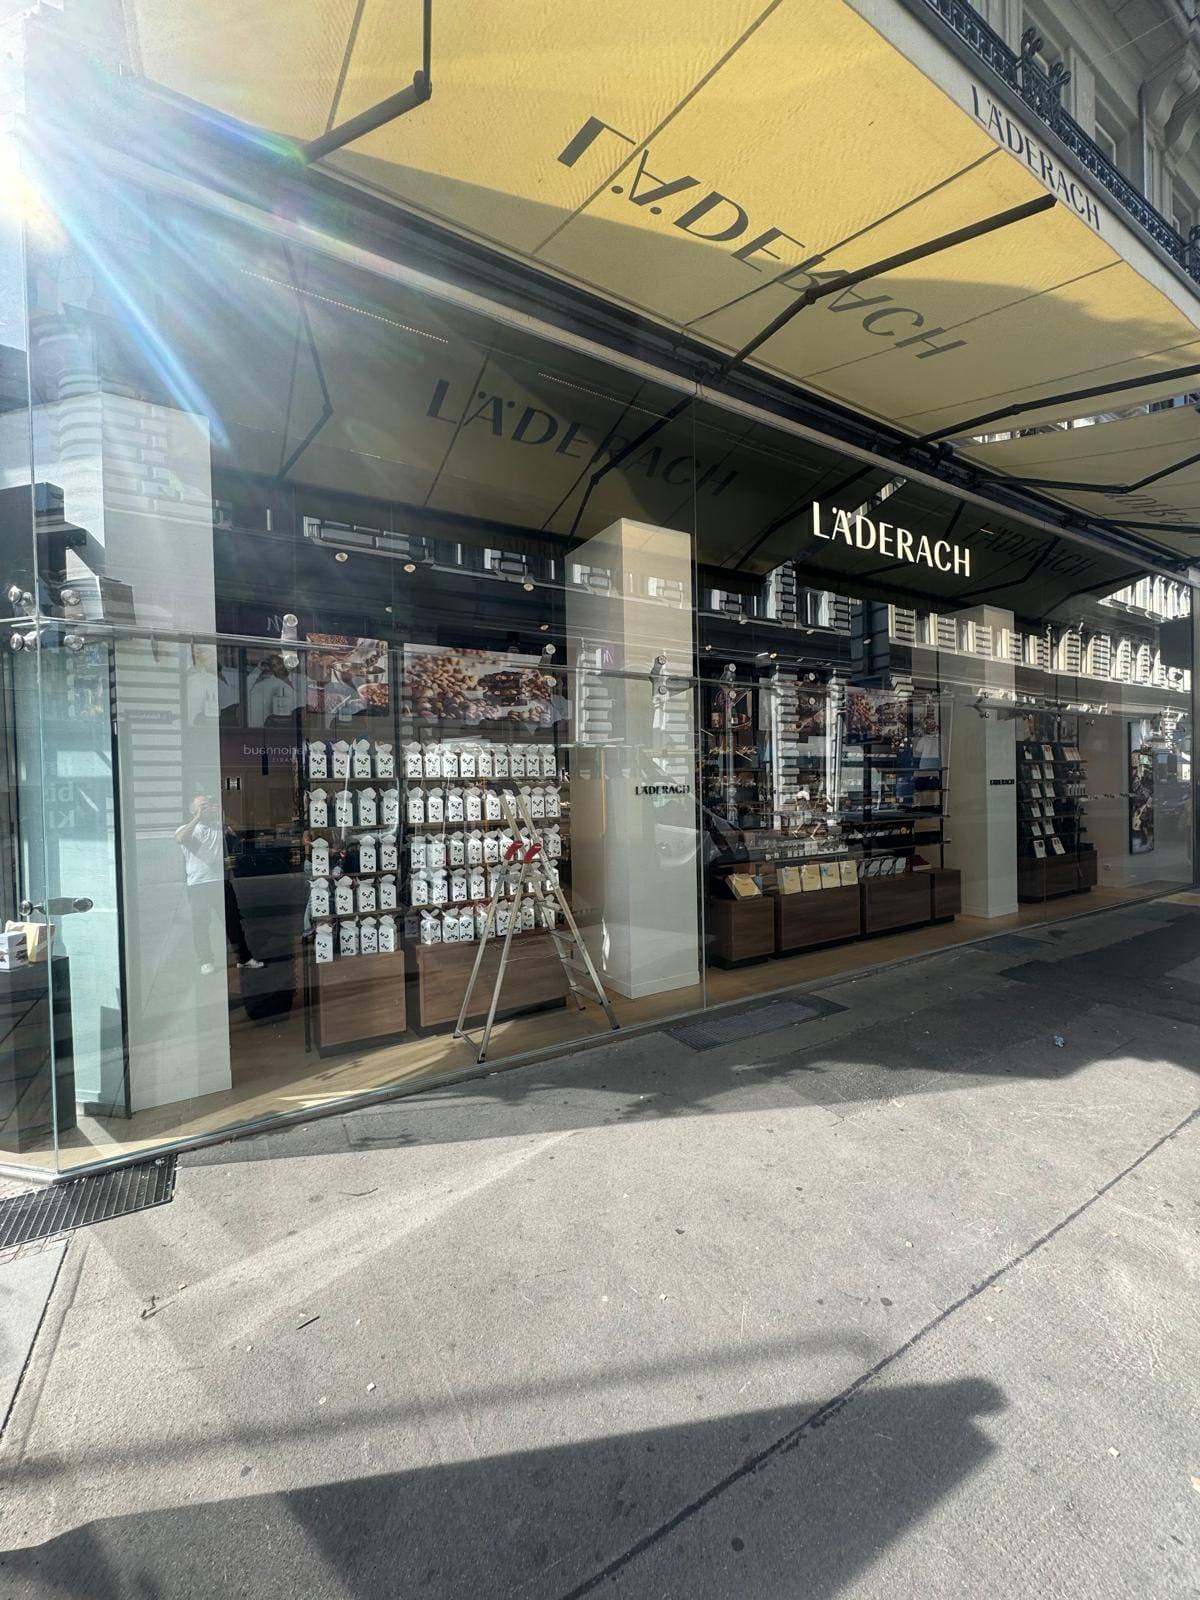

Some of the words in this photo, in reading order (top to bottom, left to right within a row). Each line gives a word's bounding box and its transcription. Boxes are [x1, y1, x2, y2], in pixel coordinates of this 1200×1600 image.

[970, 84, 1101, 231] LÄDERACH
[426, 378, 739, 497] LÄDERACH
[811, 501, 971, 578] LÄDERACH
